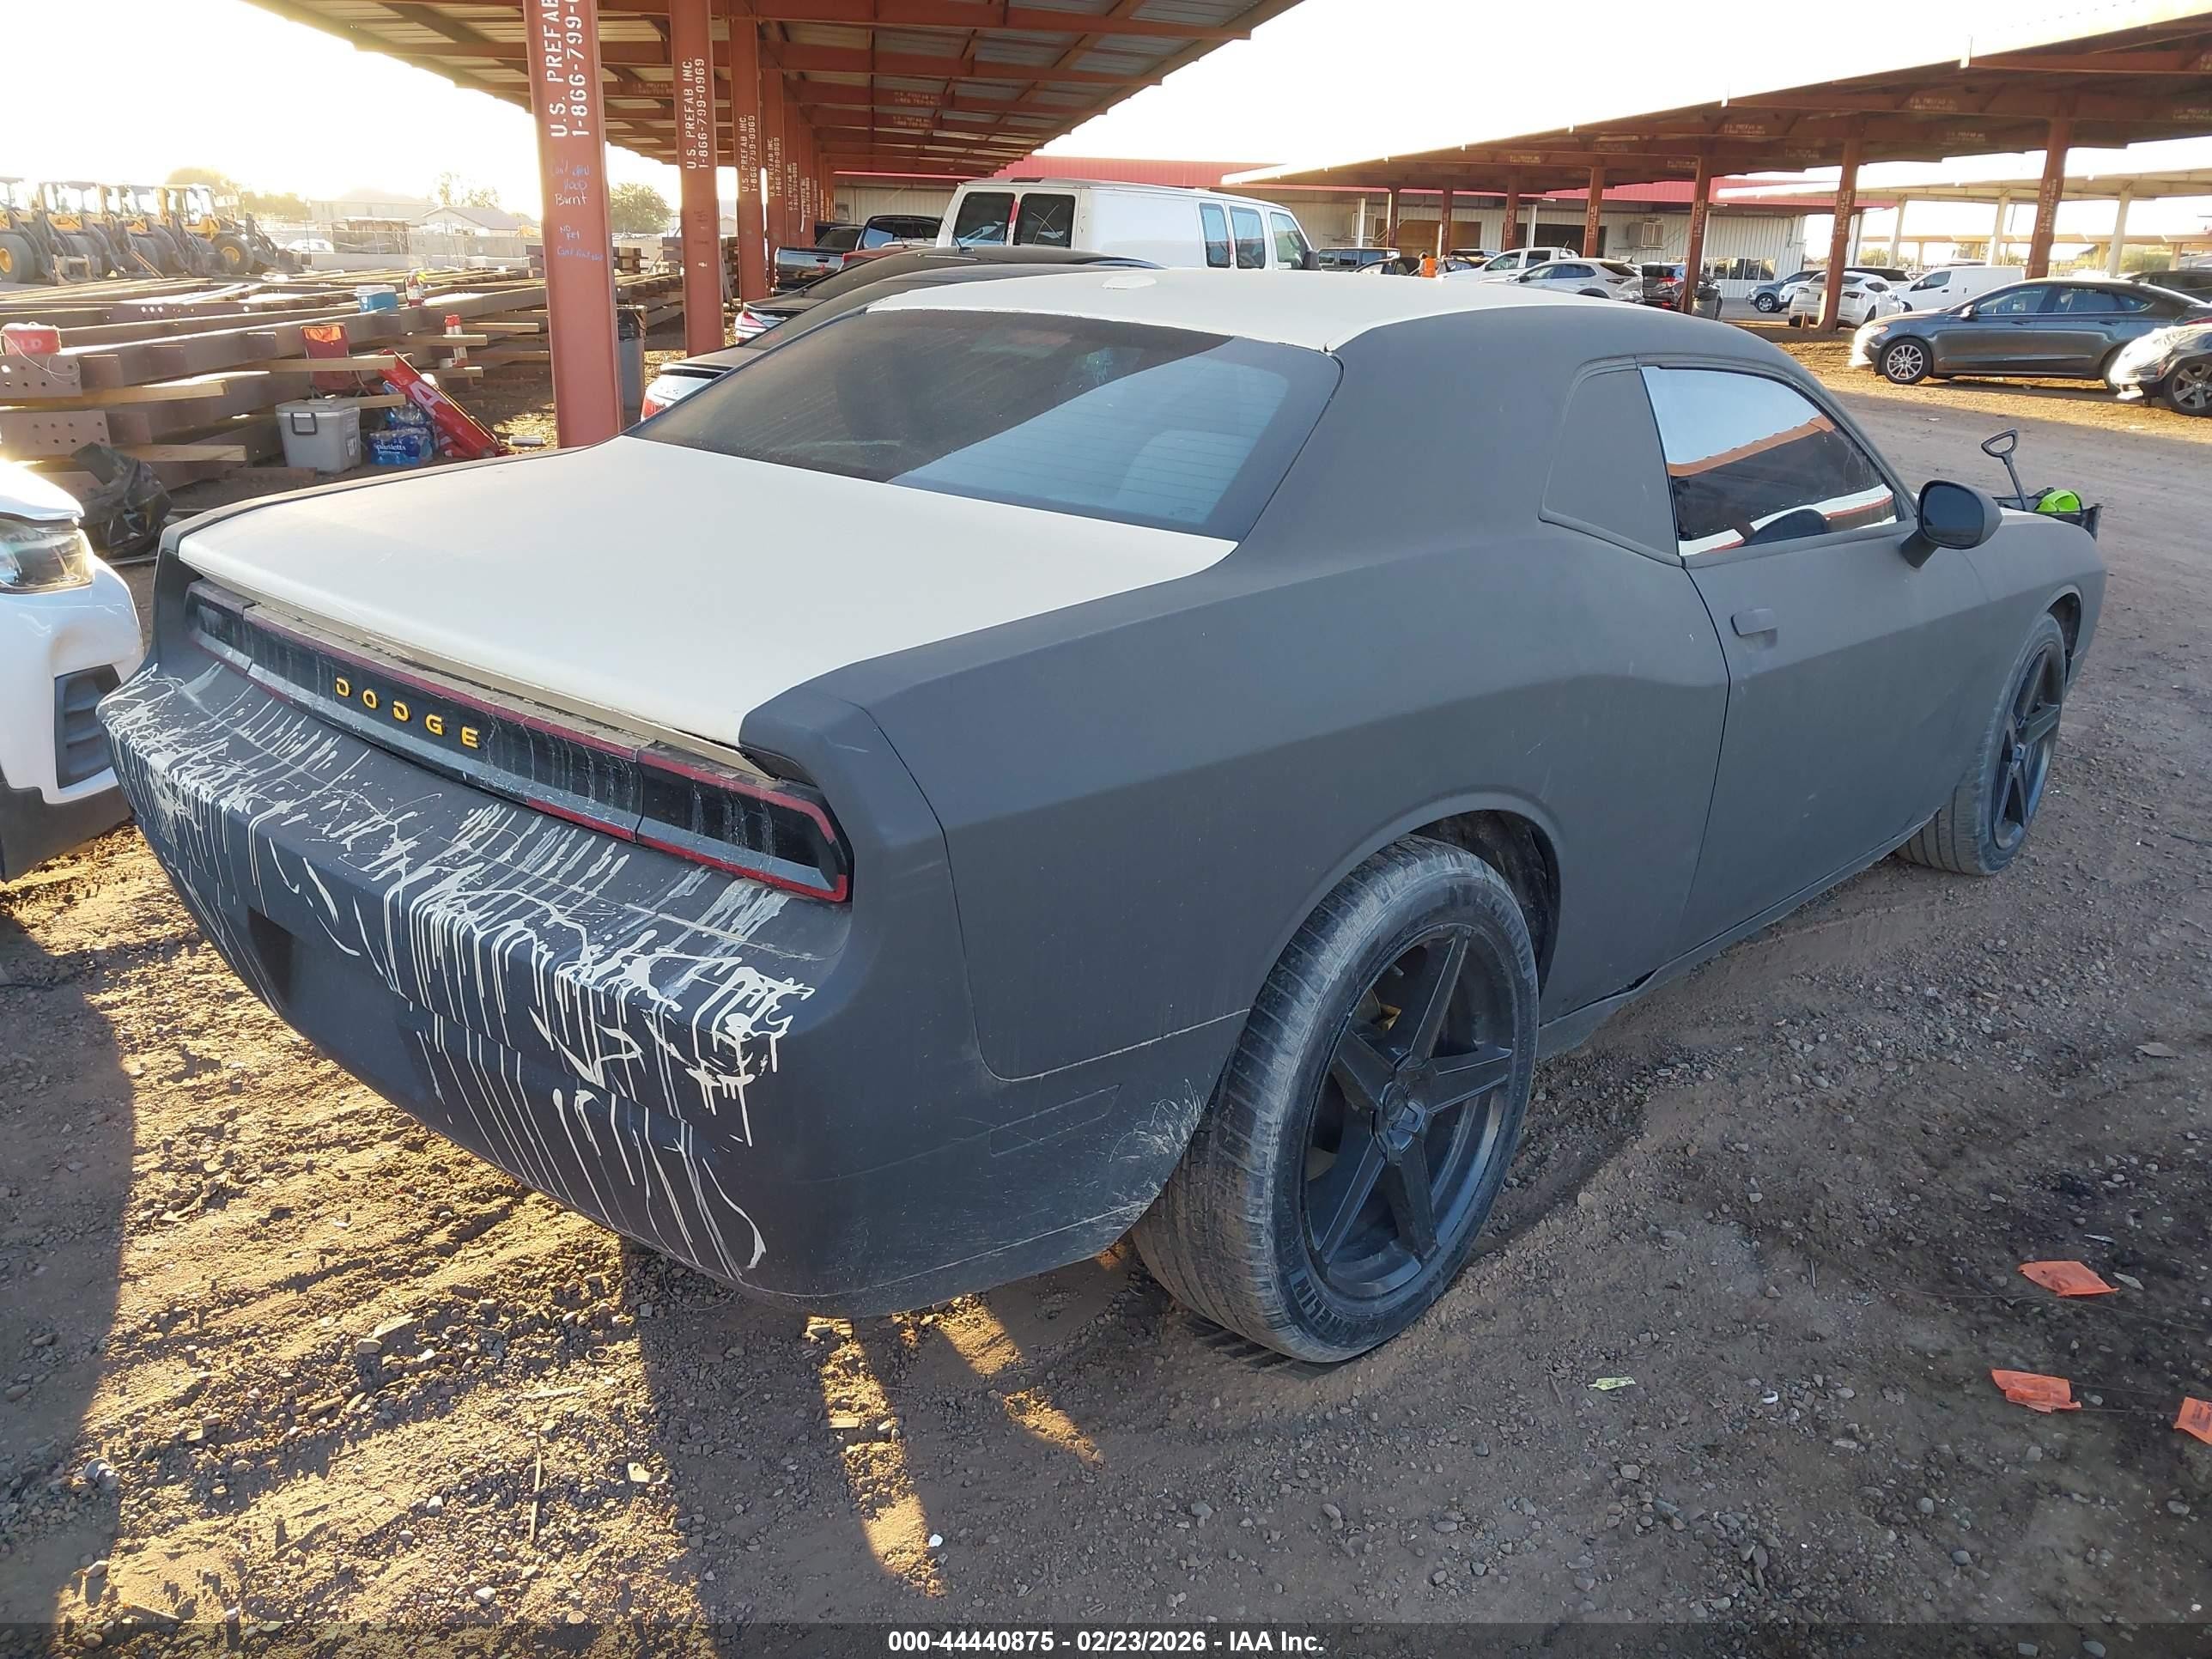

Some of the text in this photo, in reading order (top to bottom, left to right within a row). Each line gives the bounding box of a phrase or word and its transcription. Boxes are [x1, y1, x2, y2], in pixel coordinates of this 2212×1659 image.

[564, 0, 590, 136] 1-866-799-
[682, 57, 696, 169] U.S. PREFAB INC.
[695, 58, 708, 168] 1-866-799-0969
[549, 95, 568, 137] U.S.
[740, 136, 749, 171] PREFAB
[335, 676, 480, 749] DODGE
